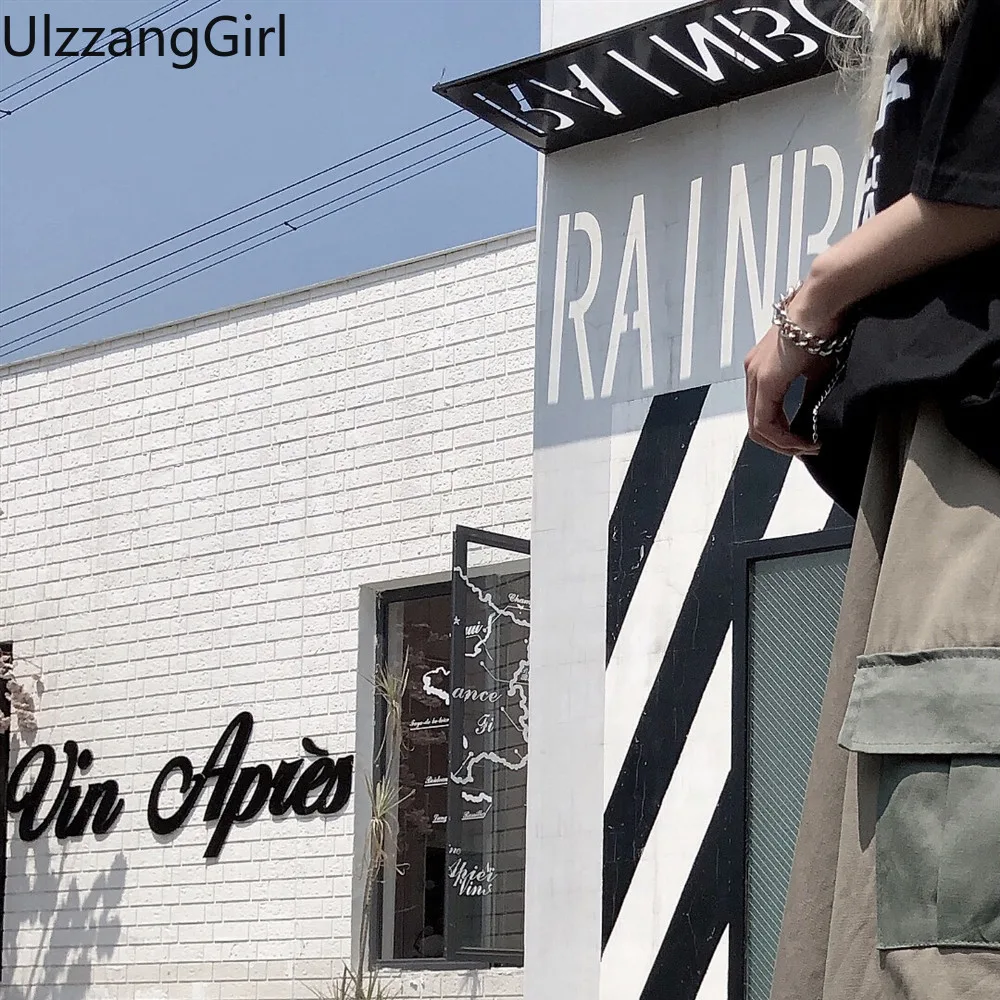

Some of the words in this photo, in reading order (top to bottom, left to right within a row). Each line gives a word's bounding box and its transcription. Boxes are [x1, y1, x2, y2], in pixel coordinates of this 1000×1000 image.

[547, 144, 868, 405] RAINB
[6, 740, 125, 841] Vin
[147, 711, 354, 858] Après
